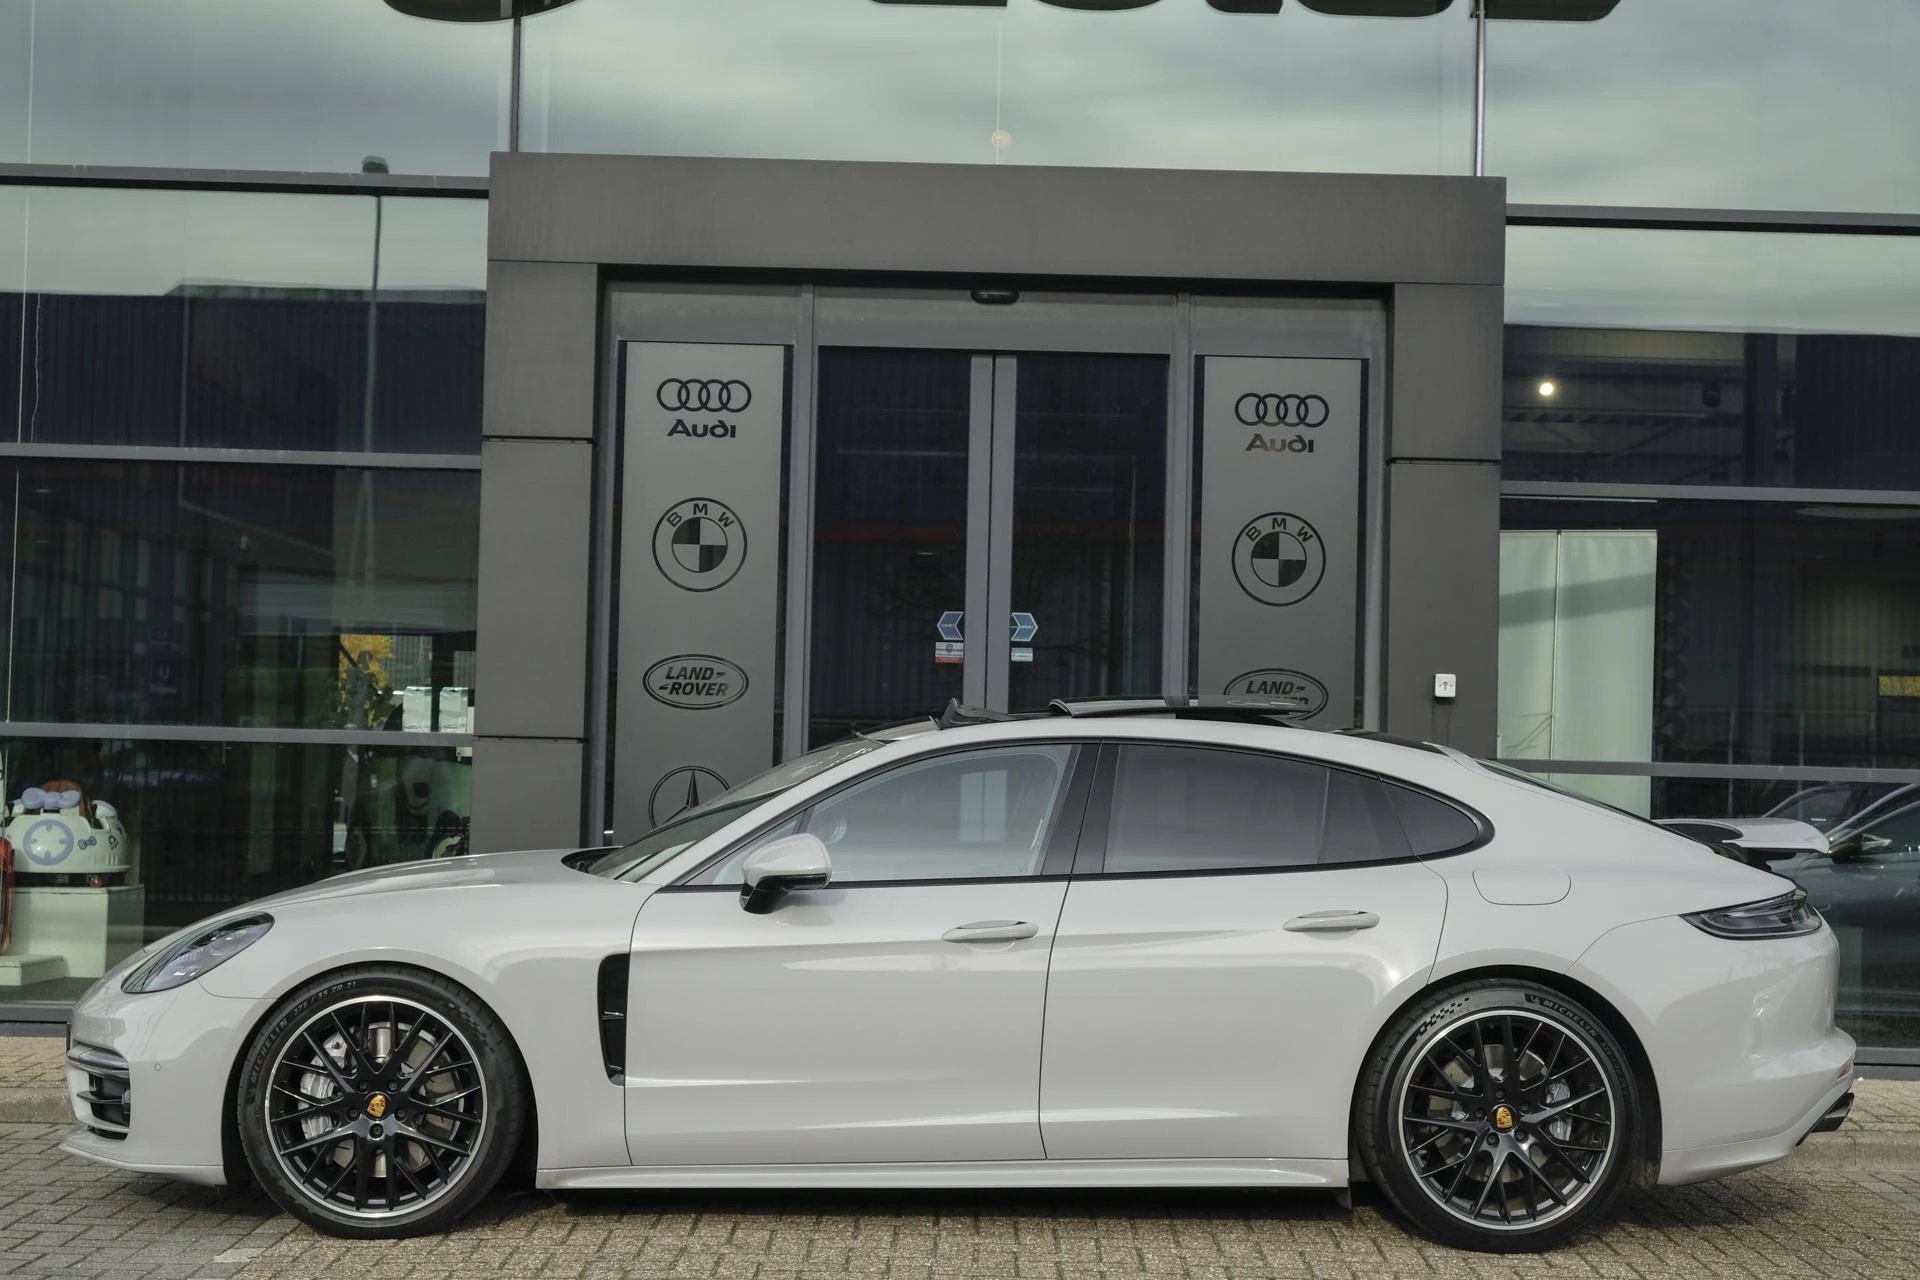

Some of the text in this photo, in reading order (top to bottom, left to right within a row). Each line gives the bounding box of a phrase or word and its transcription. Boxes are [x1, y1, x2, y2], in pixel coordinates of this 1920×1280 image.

[667, 419, 736, 438] Audi
[1246, 433, 1314, 453] Audi
[666, 503, 735, 528] BMW
[1246, 517, 1313, 543] BMW
[665, 667, 714, 680] LAND
[668, 682, 729, 696] ROVER
[1246, 680, 1295, 695] LAND
[1543, 999, 1599, 1038] MICHELIN
[251, 1018, 288, 1085] MICHELIN
